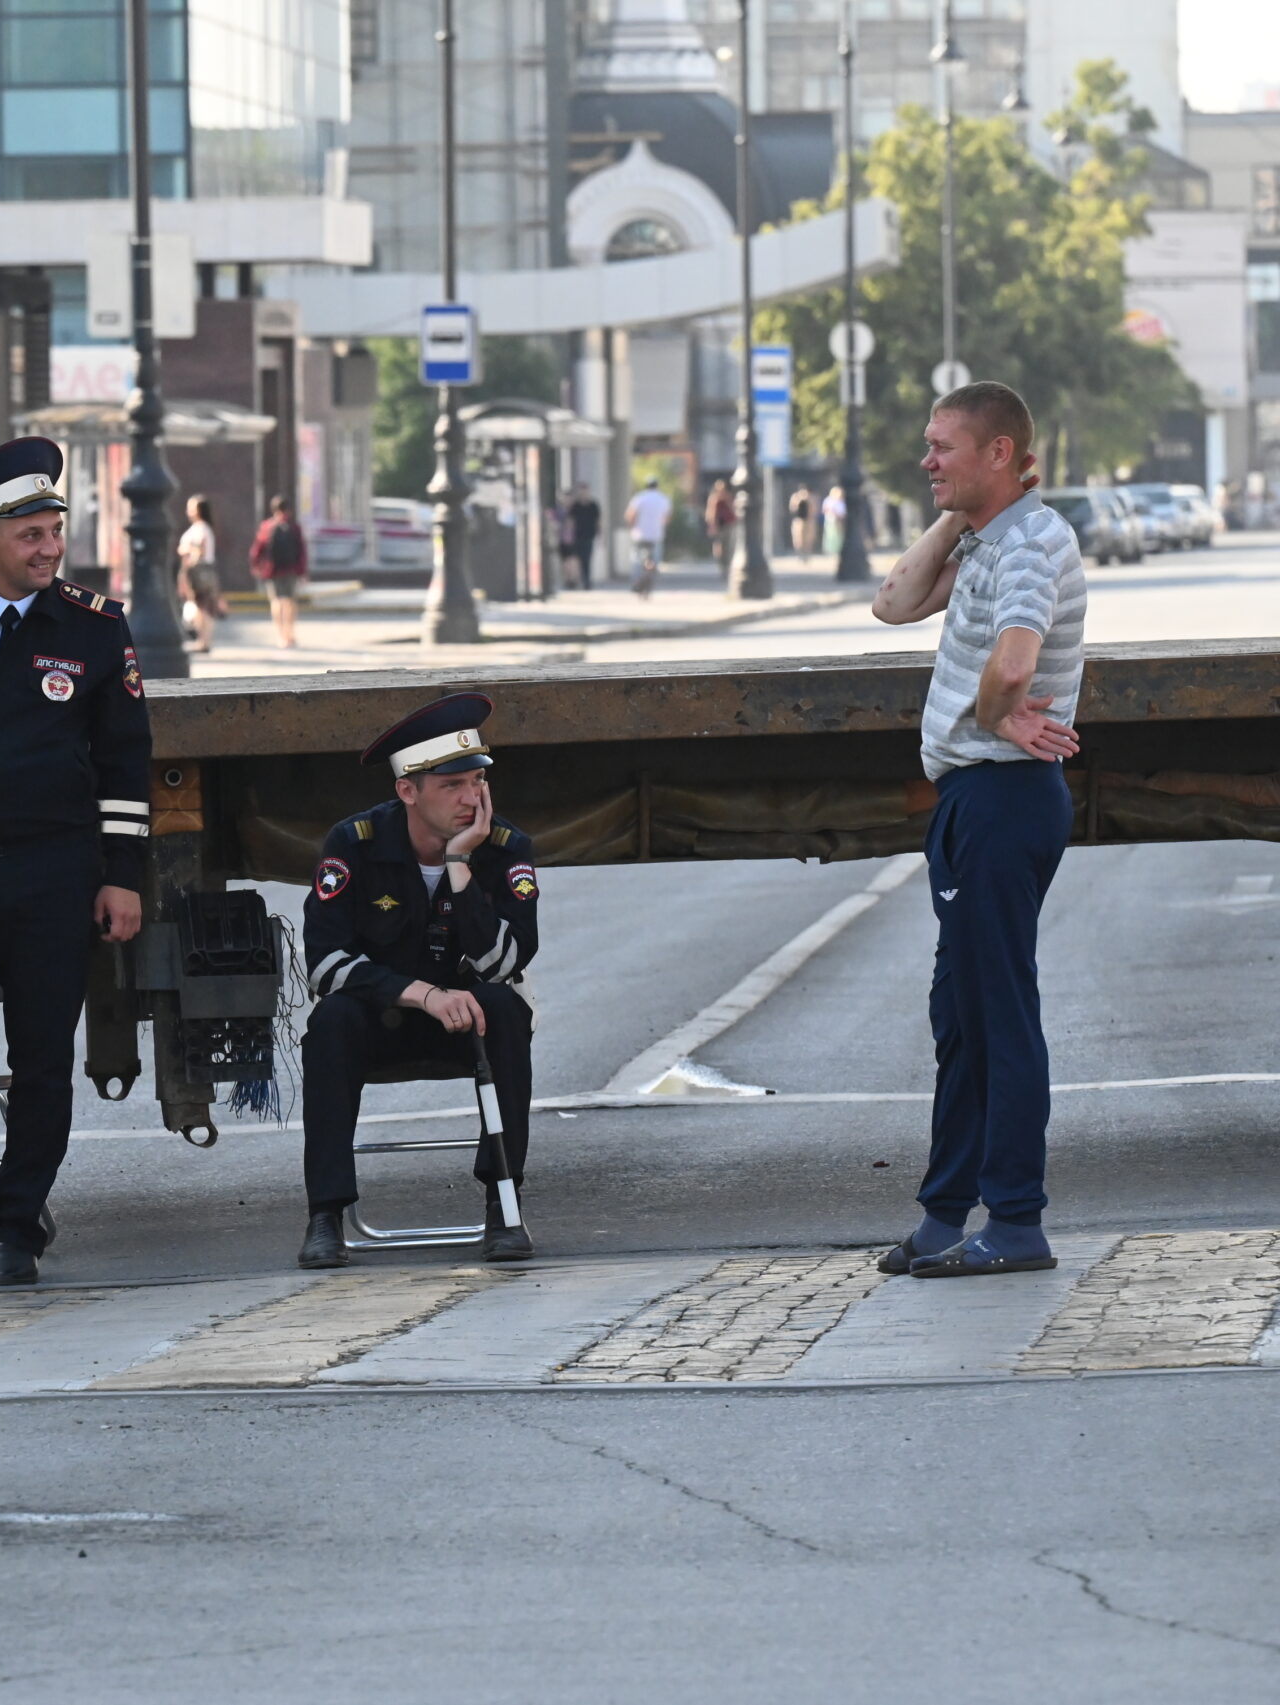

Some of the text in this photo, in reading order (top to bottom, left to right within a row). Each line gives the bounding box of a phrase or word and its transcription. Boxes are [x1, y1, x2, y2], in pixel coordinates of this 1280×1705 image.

[36, 658, 81, 673] ДПС ГИБДД
[323, 859, 350, 875] ПОЛИЦИЯ
[509, 864, 533, 874] ПОЛИЦИЯ
